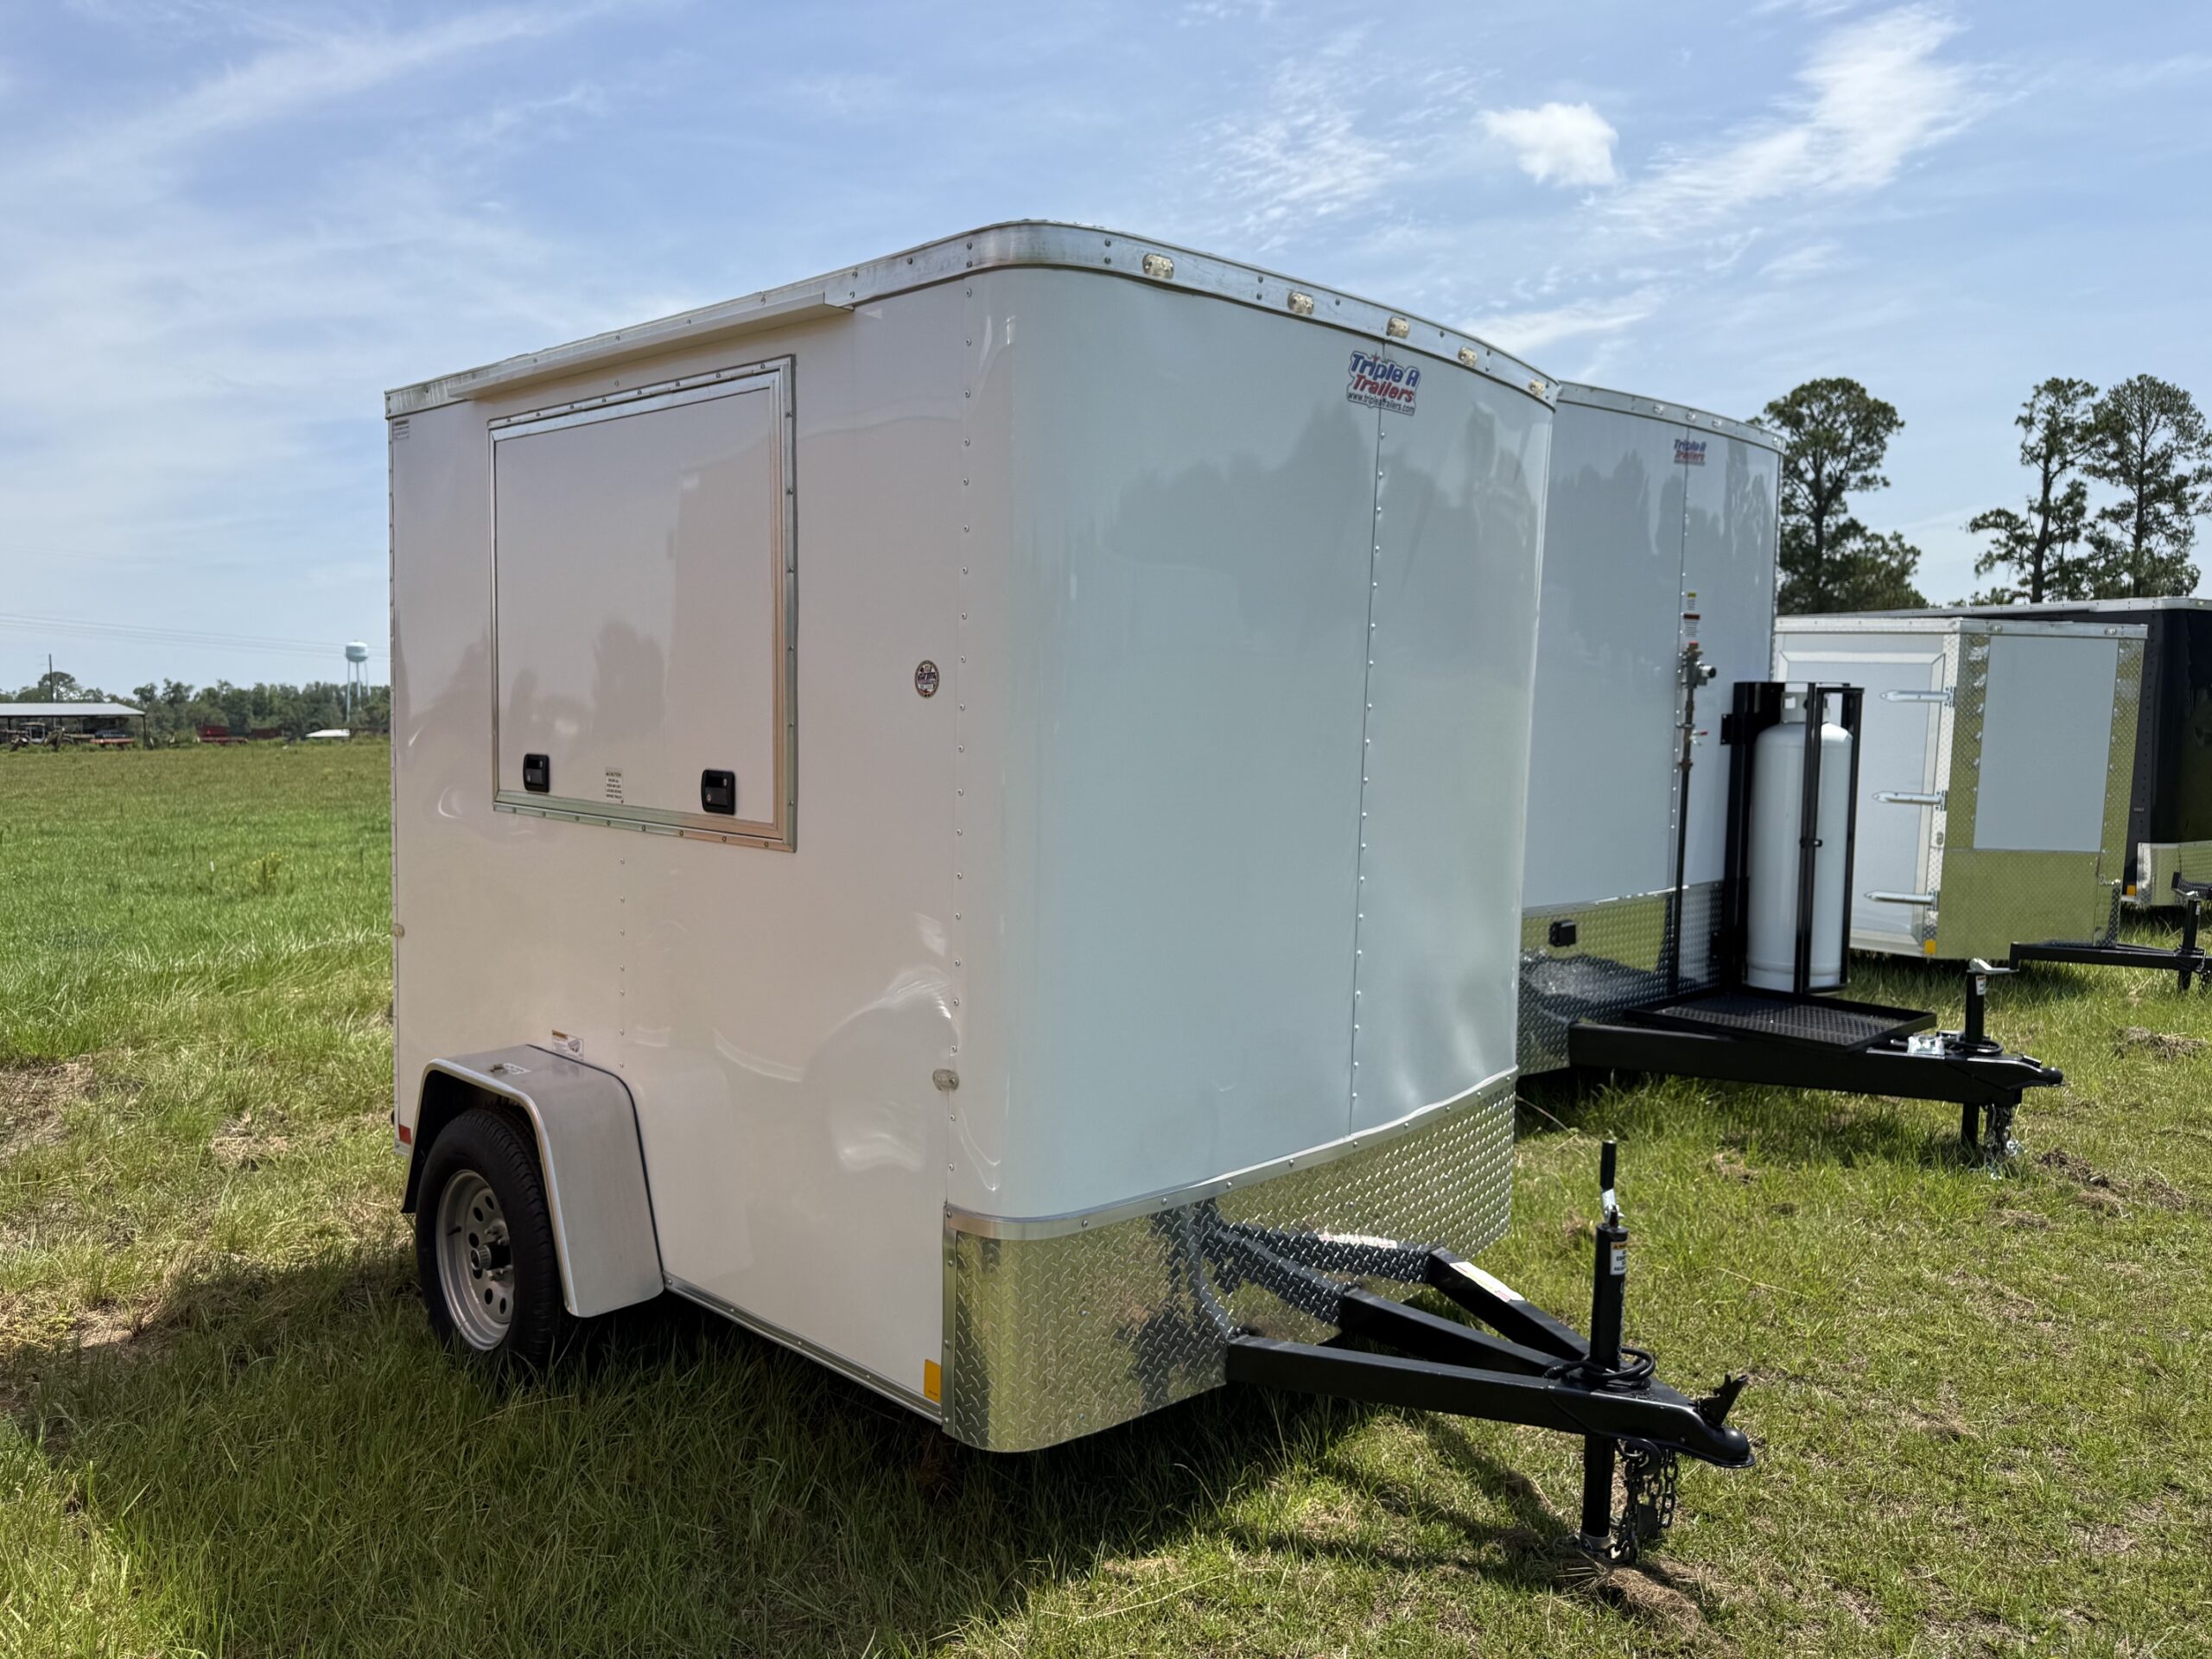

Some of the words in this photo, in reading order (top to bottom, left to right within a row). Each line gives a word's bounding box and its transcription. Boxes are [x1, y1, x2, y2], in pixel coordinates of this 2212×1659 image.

[1351, 353, 1403, 383] Triple
[1405, 369, 1421, 387] A
[1353, 373, 1414, 403] Trailers
